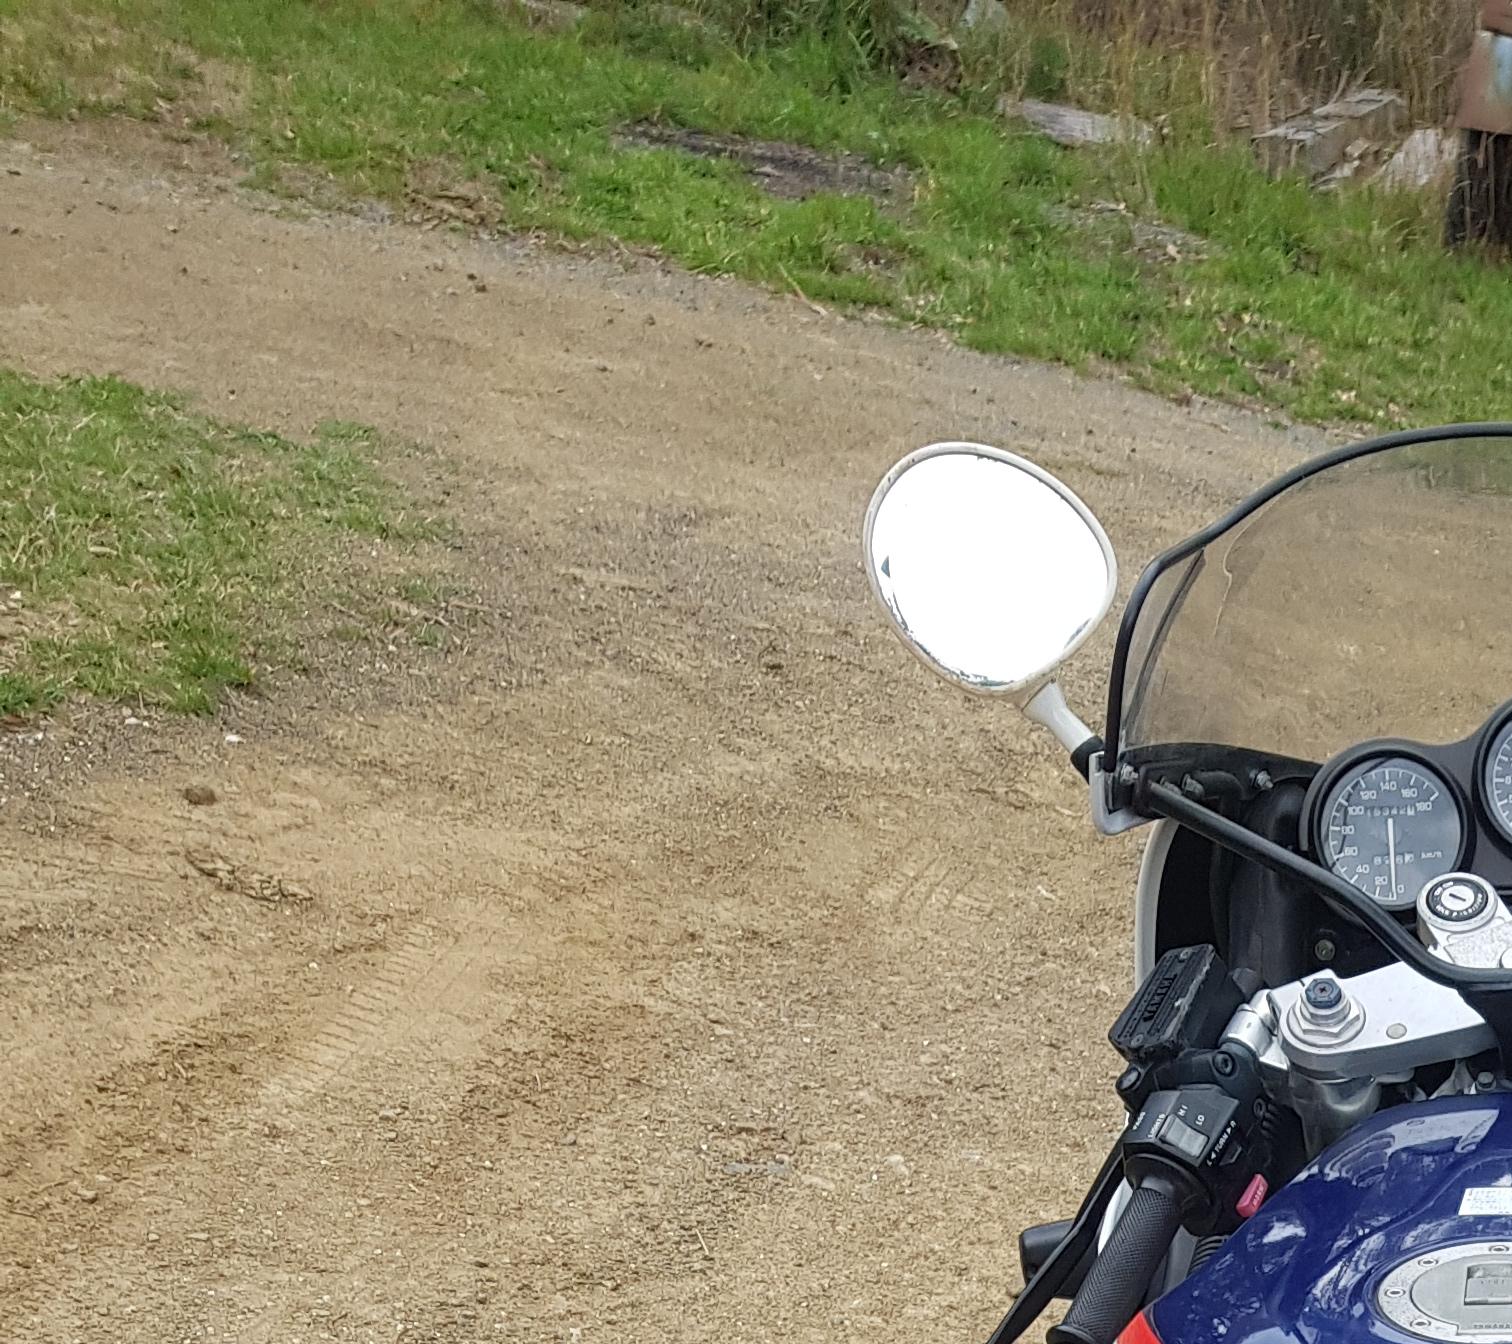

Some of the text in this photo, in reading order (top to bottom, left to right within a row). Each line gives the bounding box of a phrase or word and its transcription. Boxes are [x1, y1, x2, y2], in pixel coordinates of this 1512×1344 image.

[1505, 775, 1512, 785] 6
[1380, 781, 1397, 791] 140
[1360, 790, 1377, 800] 120
[1401, 788, 1418, 798] 160
[1348, 805, 1364, 816] 100
[1416, 801, 1432, 811] 180
[1342, 825, 1355, 834] 80
[1344, 846, 1358, 856] 60
[1356, 864, 1370, 873] 40
[1374, 876, 1388, 885] 20
[1397, 884, 1405, 893] 0
